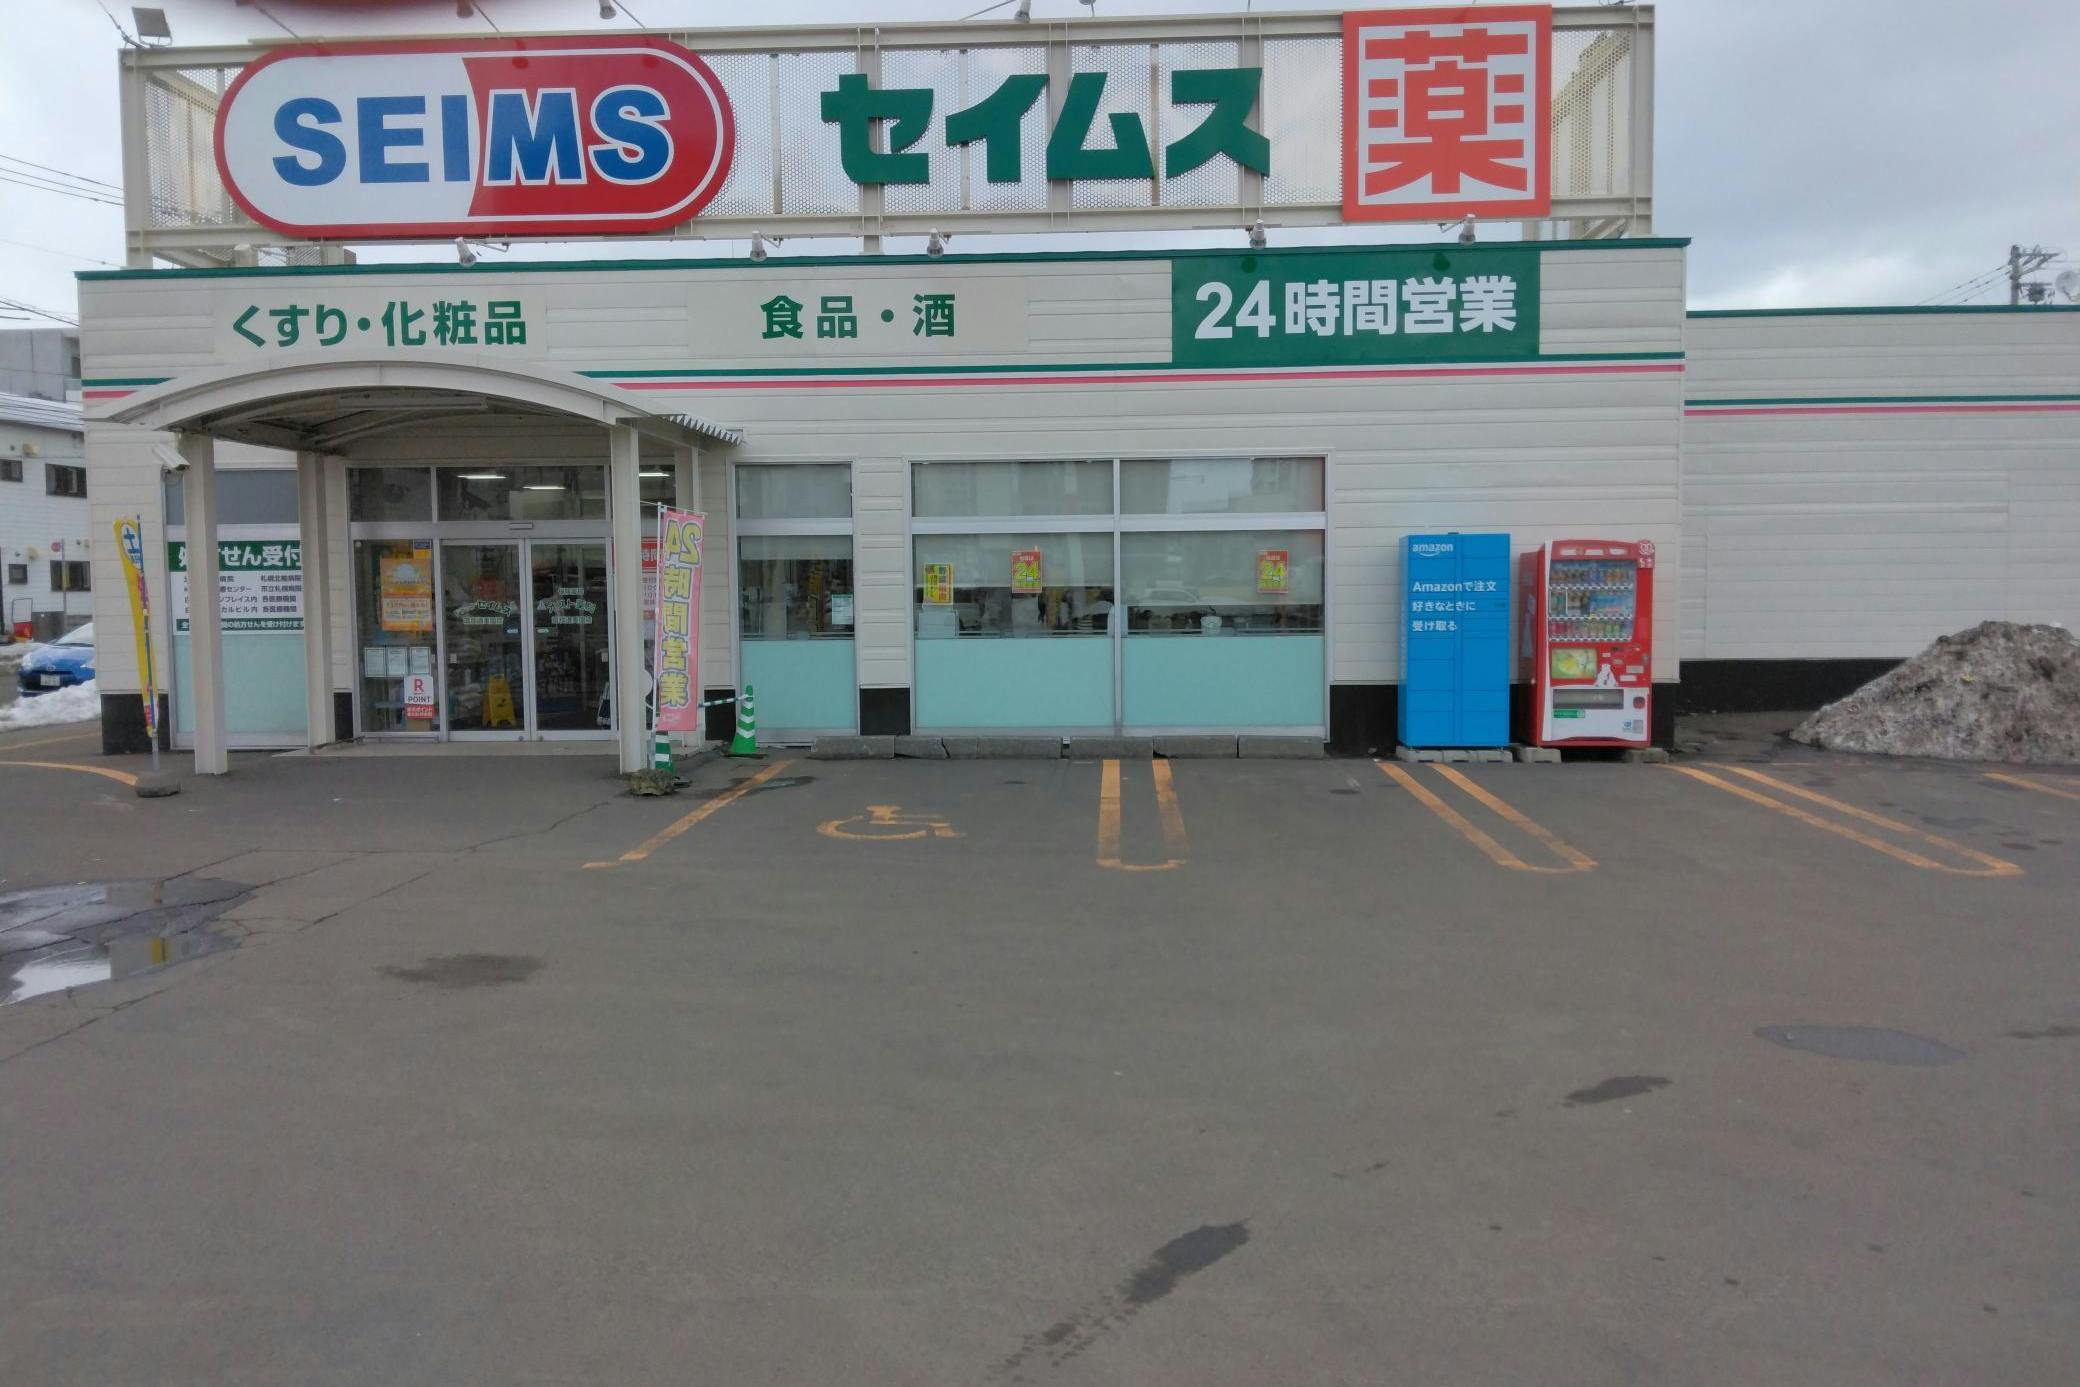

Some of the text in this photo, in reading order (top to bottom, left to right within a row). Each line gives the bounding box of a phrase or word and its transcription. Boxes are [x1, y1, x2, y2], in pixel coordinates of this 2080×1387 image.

[272, 85, 675, 187] SEIMS
[820, 66, 1270, 186] セイムス
[1363, 29, 1529, 198] 薬
[232, 300, 527, 348] くすり・化粧品
[761, 293, 956, 340] 食品・酒
[1194, 273, 1518, 340] 24時間営業
[1412, 543, 1453, 555] amazon
[1412, 580, 1497, 592] Amazonで注文
[1412, 600, 1477, 612] 好きなときに
[1412, 620, 1457, 632] 受け取る
[407, 695, 431, 703] POINT
